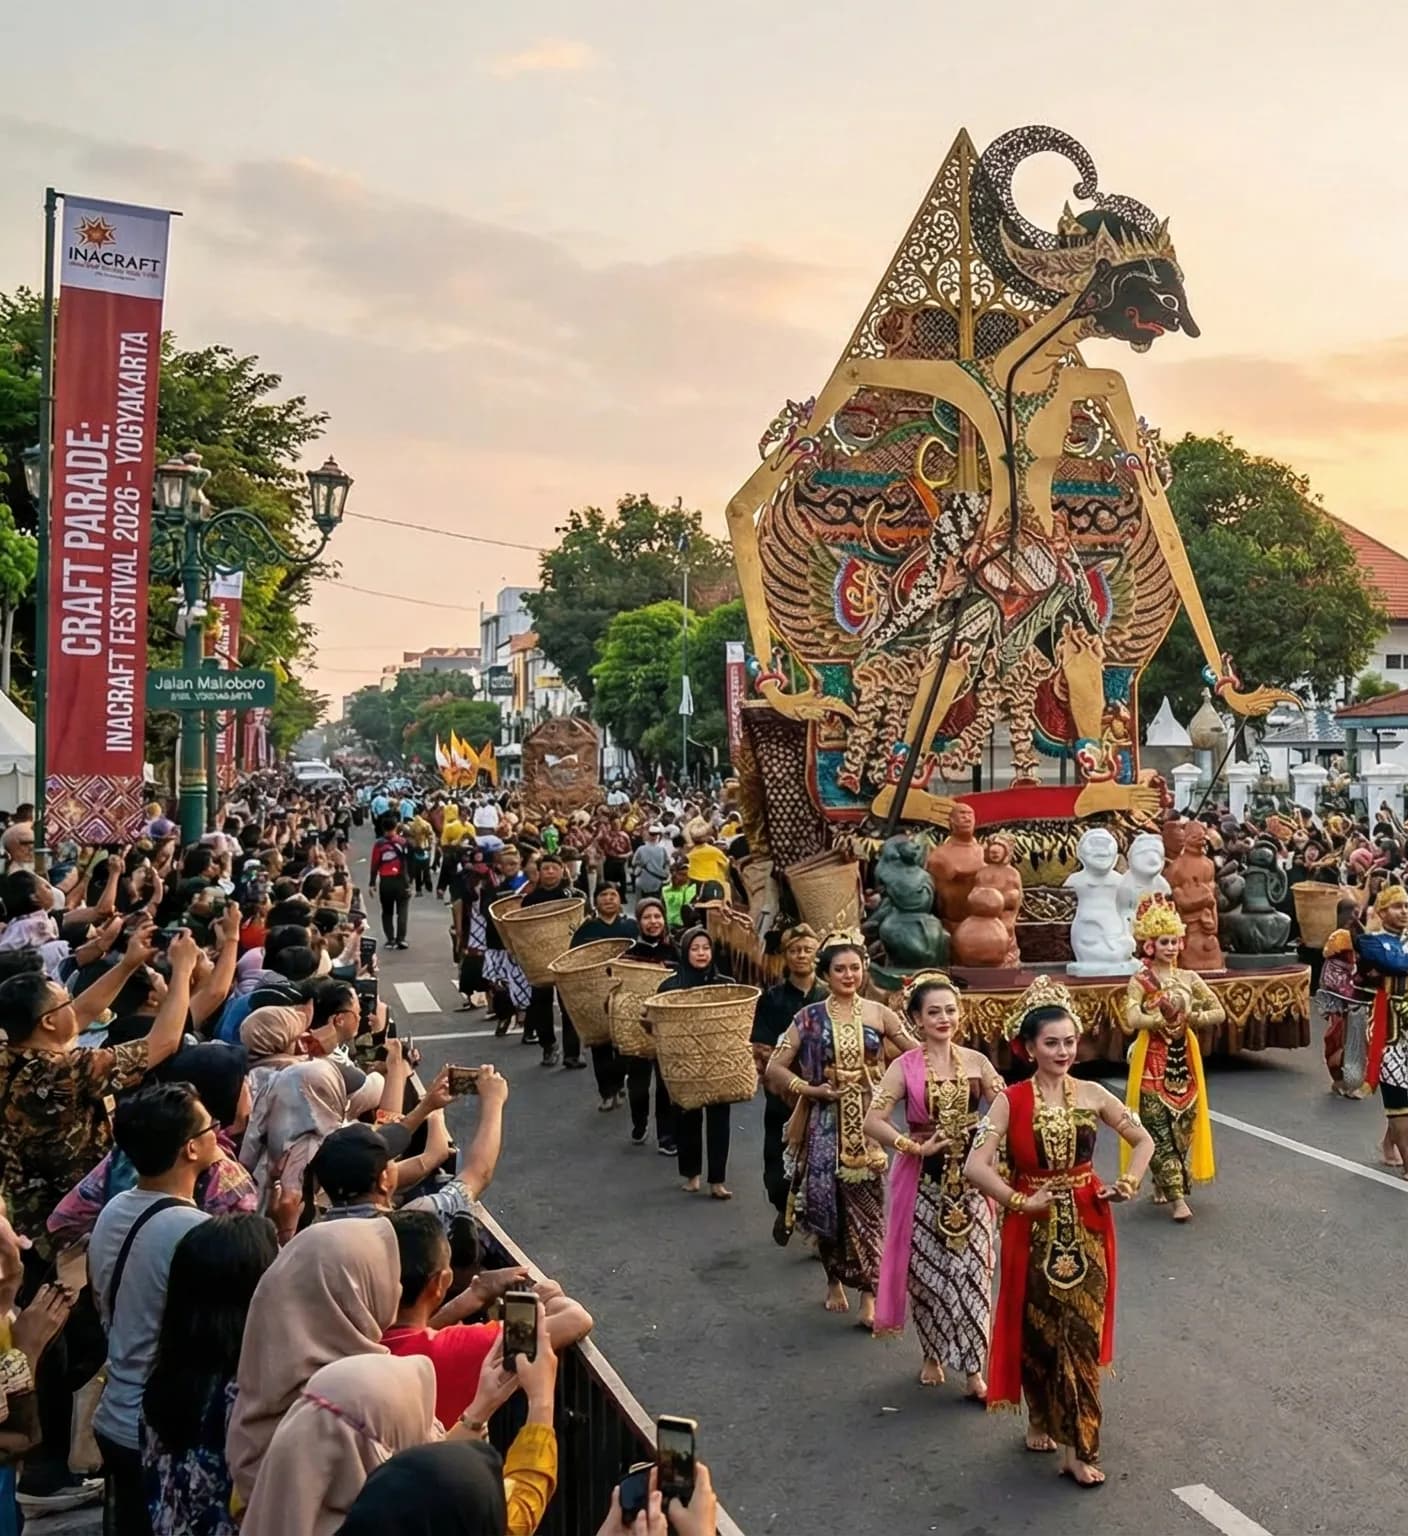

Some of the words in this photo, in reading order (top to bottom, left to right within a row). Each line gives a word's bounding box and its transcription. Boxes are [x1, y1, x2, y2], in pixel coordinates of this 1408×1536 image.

[69, 246, 160, 272] INACRAFT
[115, 332, 149, 465] YOGYAKARTA
[63, 421, 110, 550] PARADE:
[112, 486, 141, 542] 2026
[61, 558, 105, 656] CRAFT
[109, 549, 139, 645] FESTIVAL
[106, 648, 136, 752] INACRAFT
[154, 676, 193, 690] Jalan
